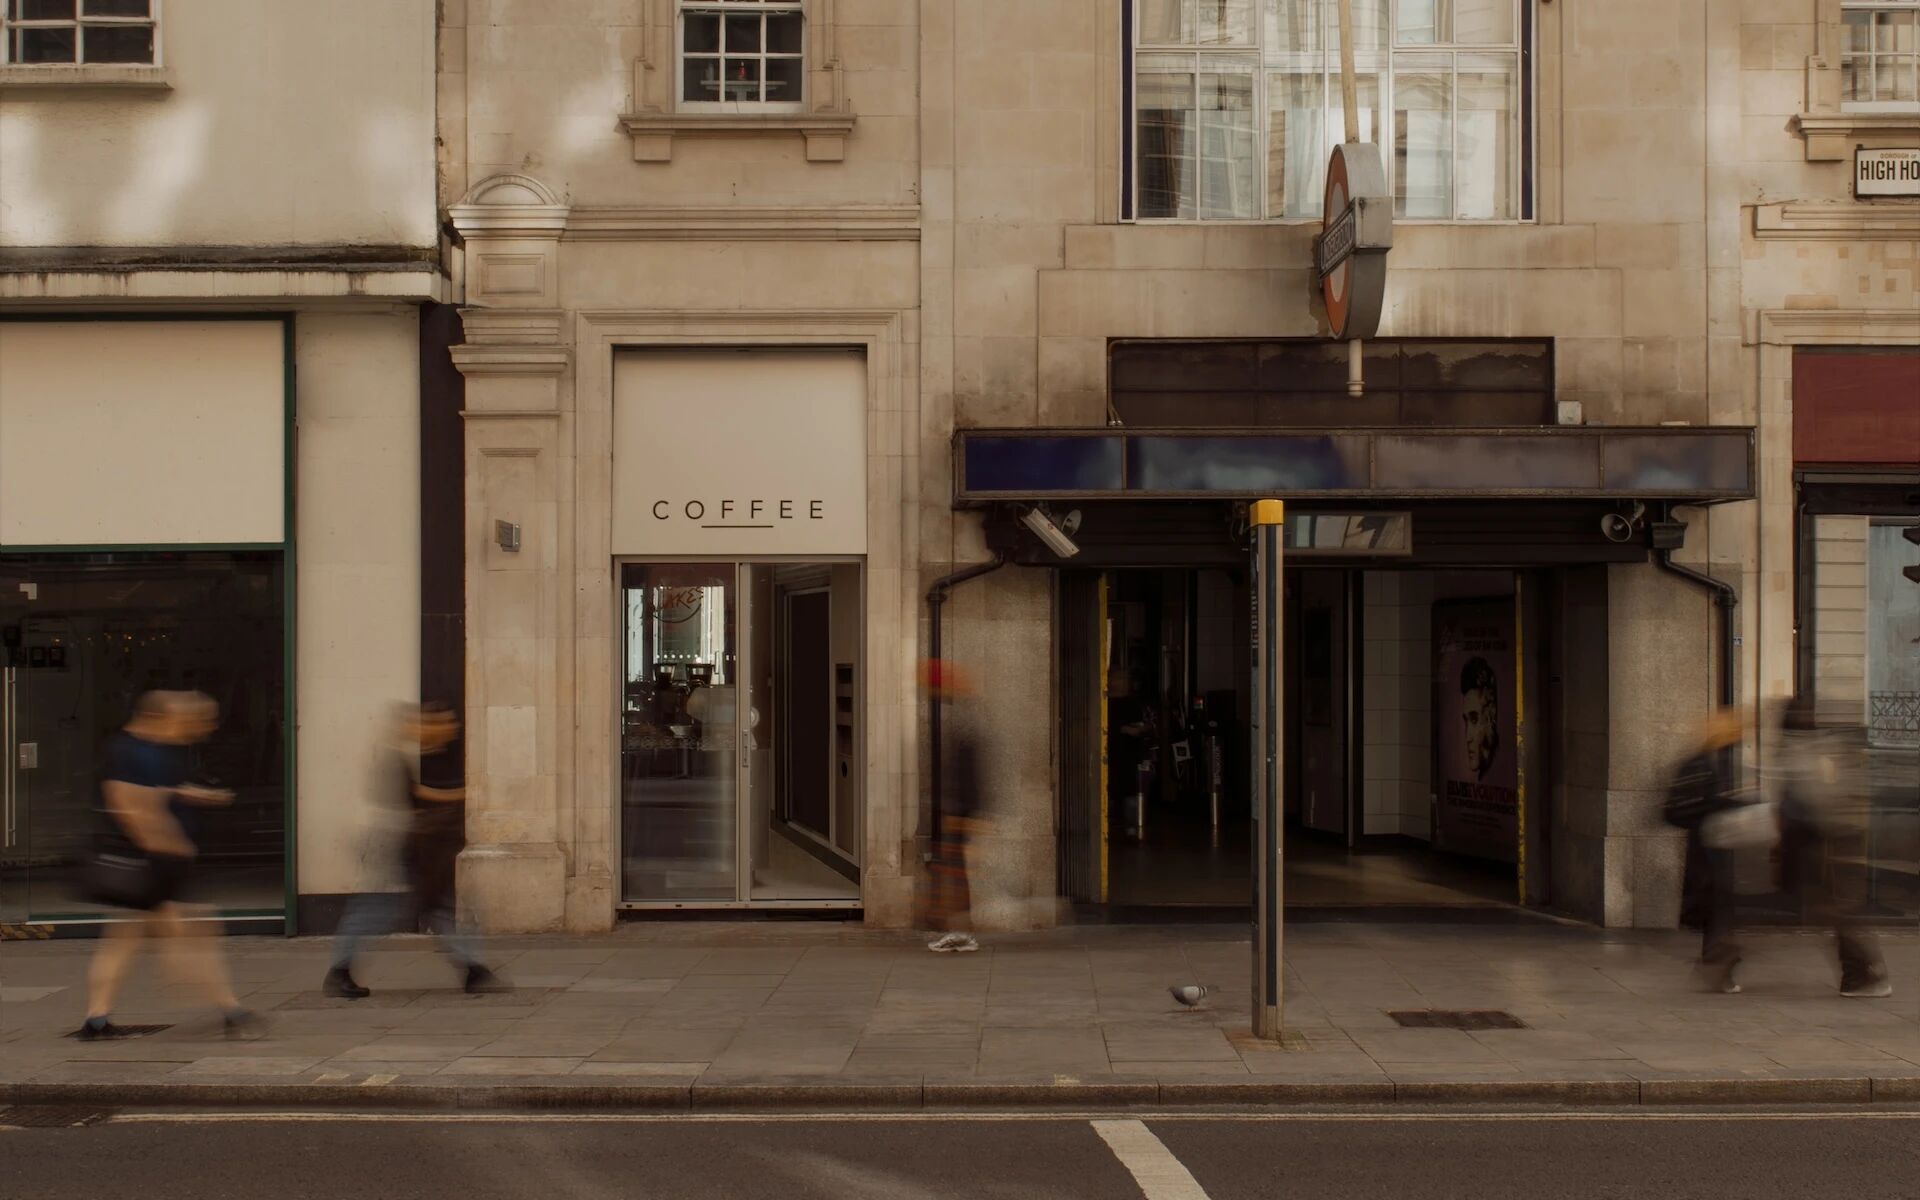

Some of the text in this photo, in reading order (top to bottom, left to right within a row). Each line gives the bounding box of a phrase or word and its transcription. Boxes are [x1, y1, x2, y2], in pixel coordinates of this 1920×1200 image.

[1860, 160, 1920, 180] HIGH HO
[653, 500, 823, 520] COFFEE
